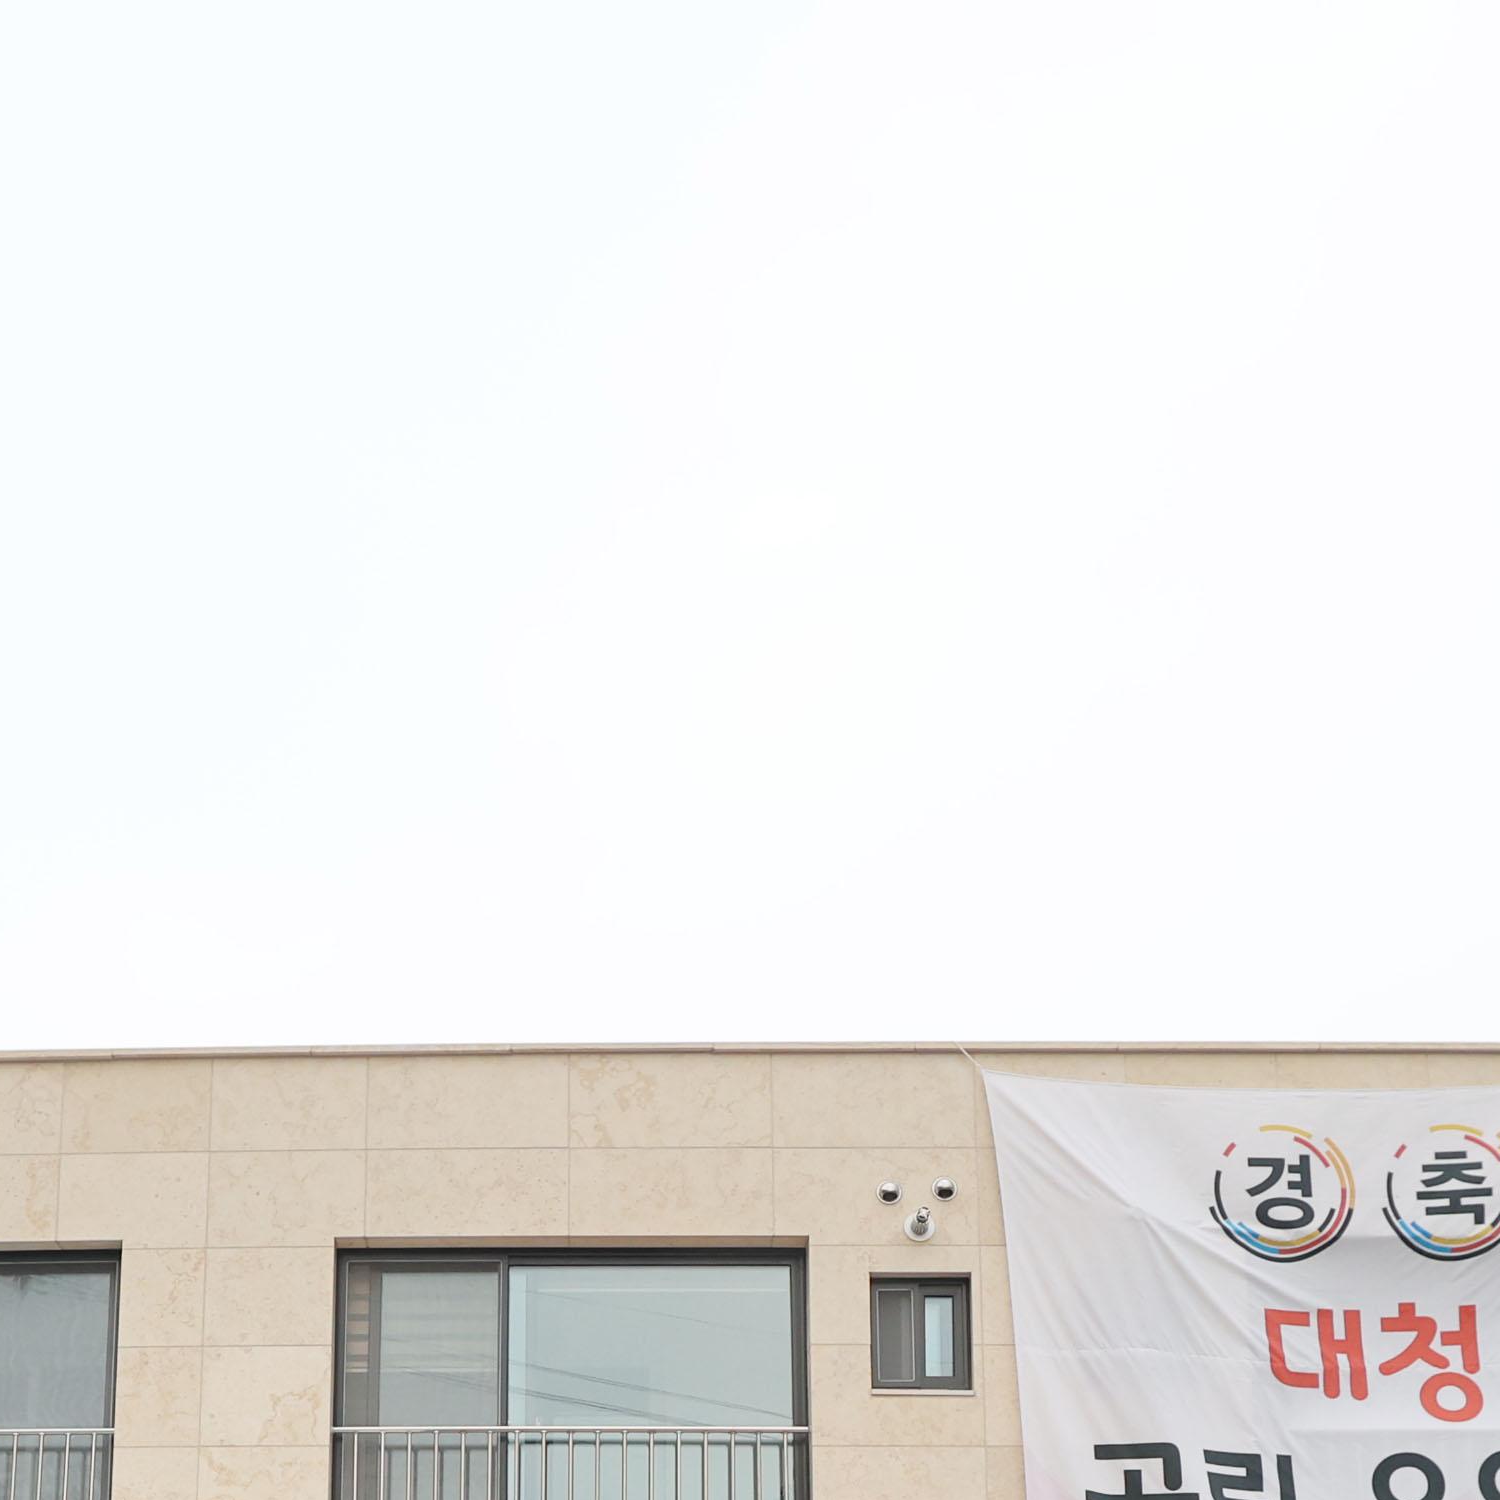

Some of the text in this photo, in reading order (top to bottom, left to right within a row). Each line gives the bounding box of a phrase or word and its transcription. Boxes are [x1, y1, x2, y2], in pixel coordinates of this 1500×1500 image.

[1247, 1151, 1493, 1229] 경 축
[1266, 1303, 1482, 1421] 대청
